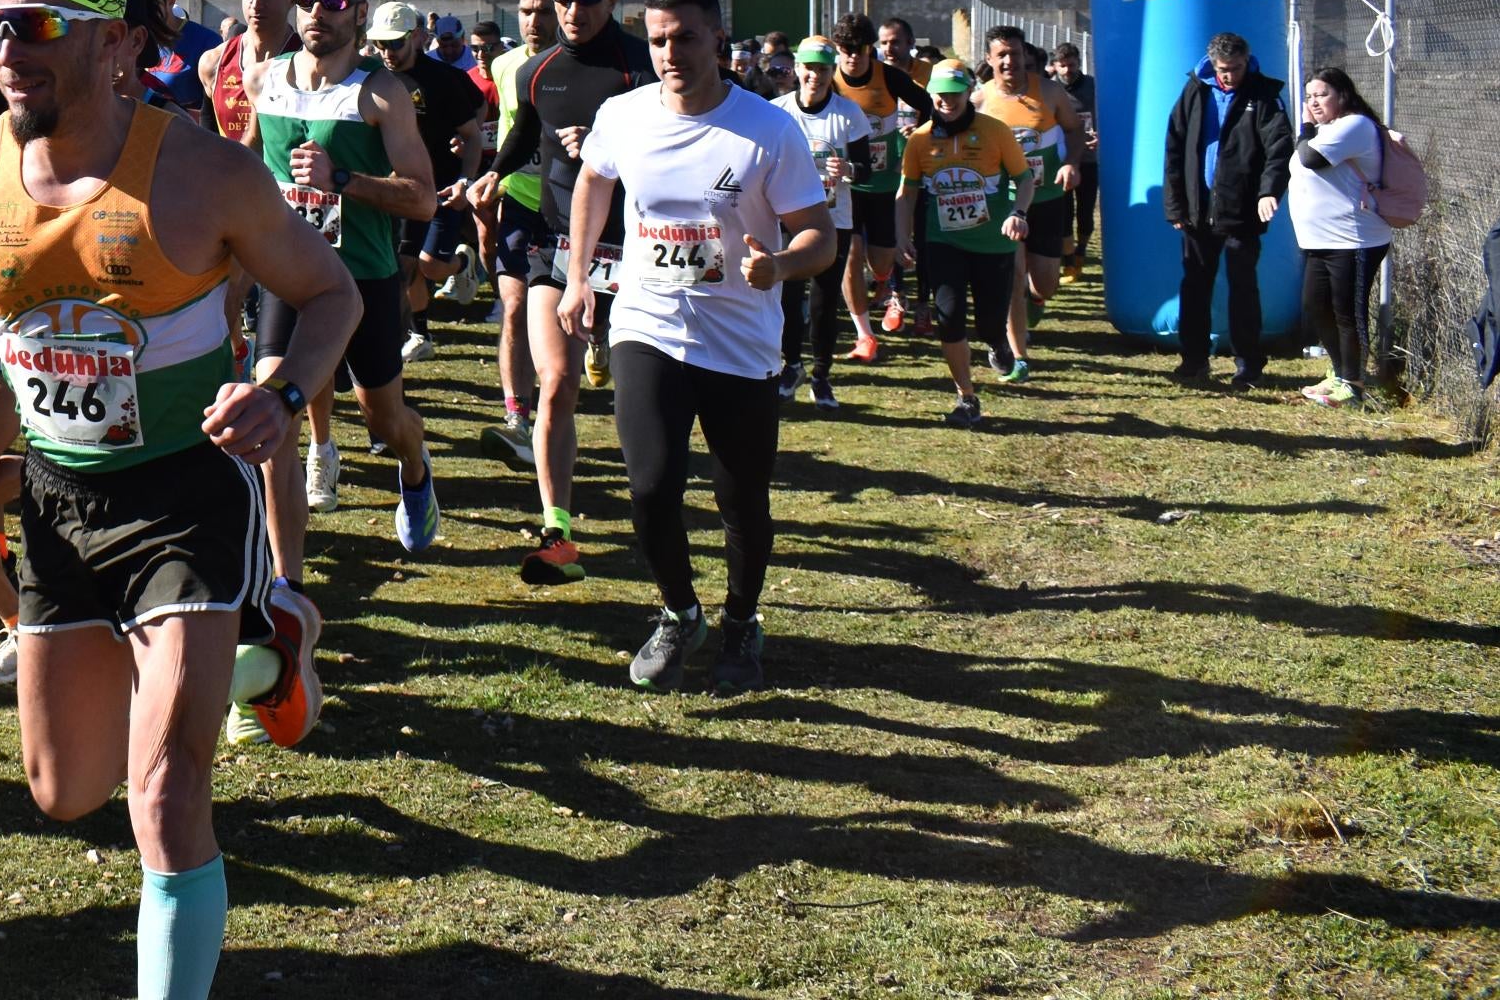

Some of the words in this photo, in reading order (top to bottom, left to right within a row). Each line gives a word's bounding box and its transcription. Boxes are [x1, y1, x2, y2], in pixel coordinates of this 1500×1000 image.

[947, 205, 978, 222] 212
[638, 222, 721, 242] bedunia
[653, 243, 706, 269] 244
[4, 338, 132, 377] bedunia
[27, 377, 107, 423] 246
